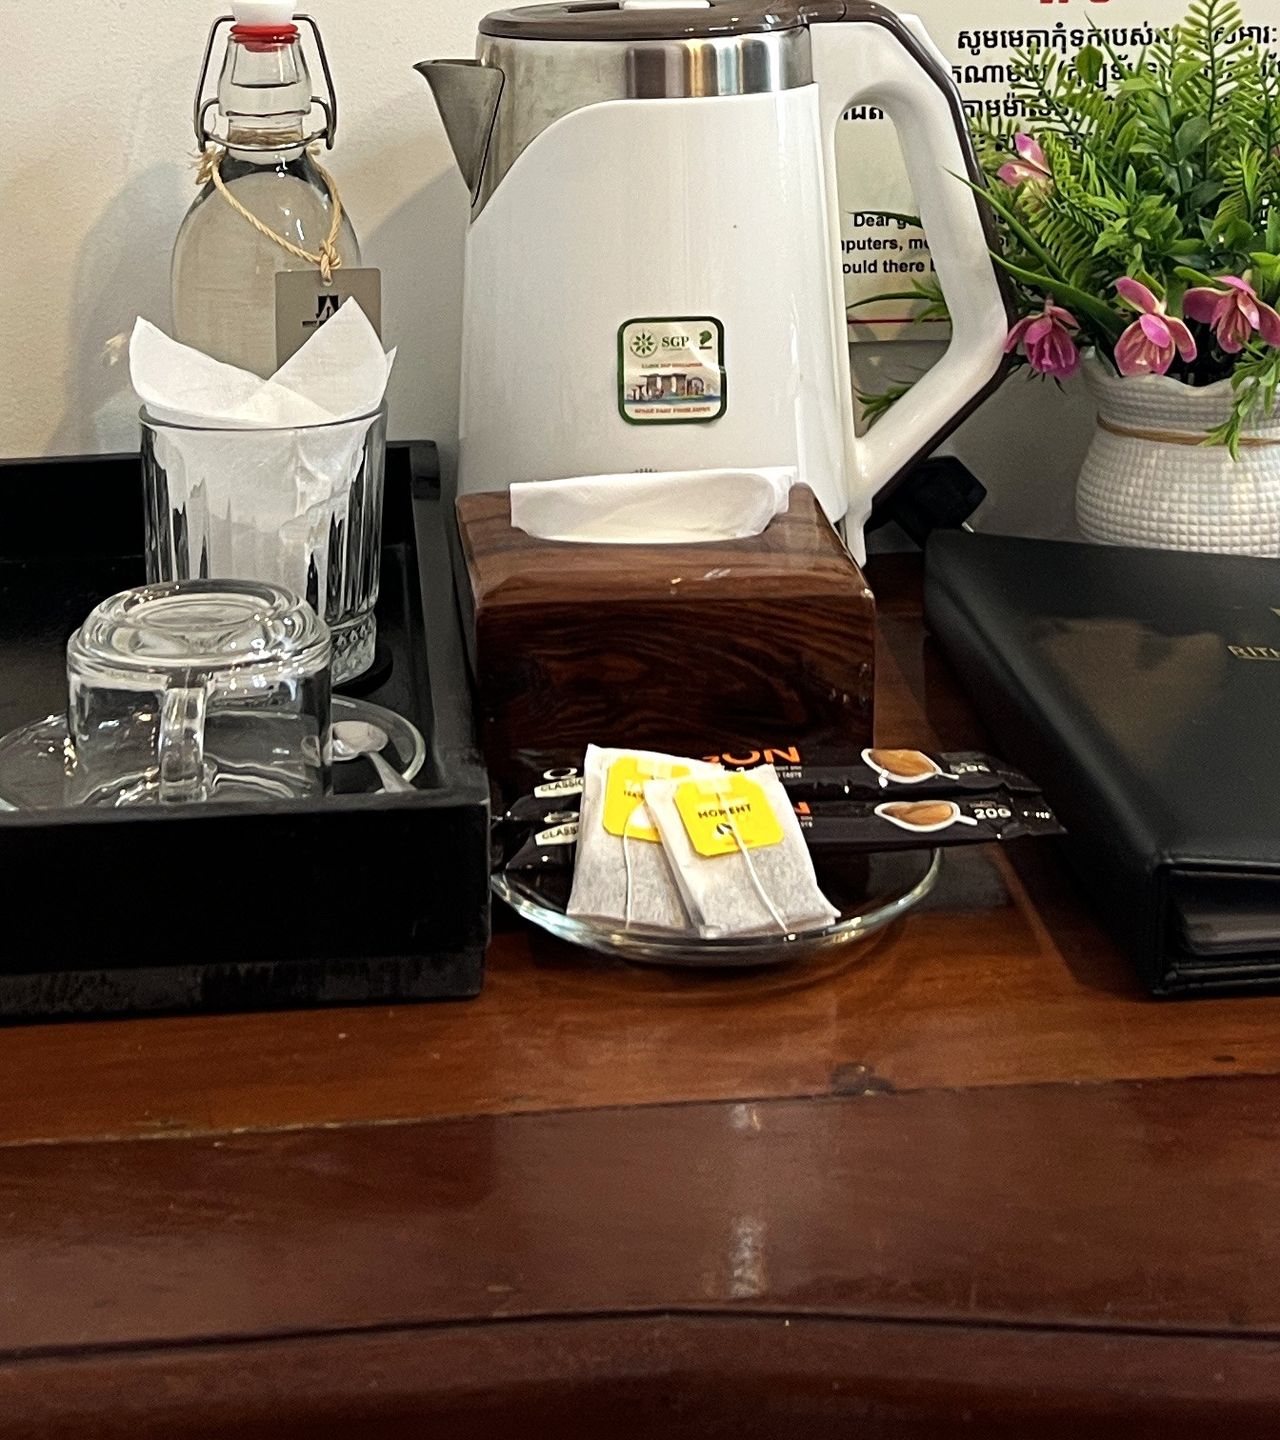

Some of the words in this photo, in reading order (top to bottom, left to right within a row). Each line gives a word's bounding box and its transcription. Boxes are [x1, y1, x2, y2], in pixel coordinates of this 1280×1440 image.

[853, 213, 891, 227] Dear
[841, 237, 903, 251] puters,
[843, 260, 878, 274] ould
[883, 260, 925, 273] there
[661, 336, 689, 347] SGP
